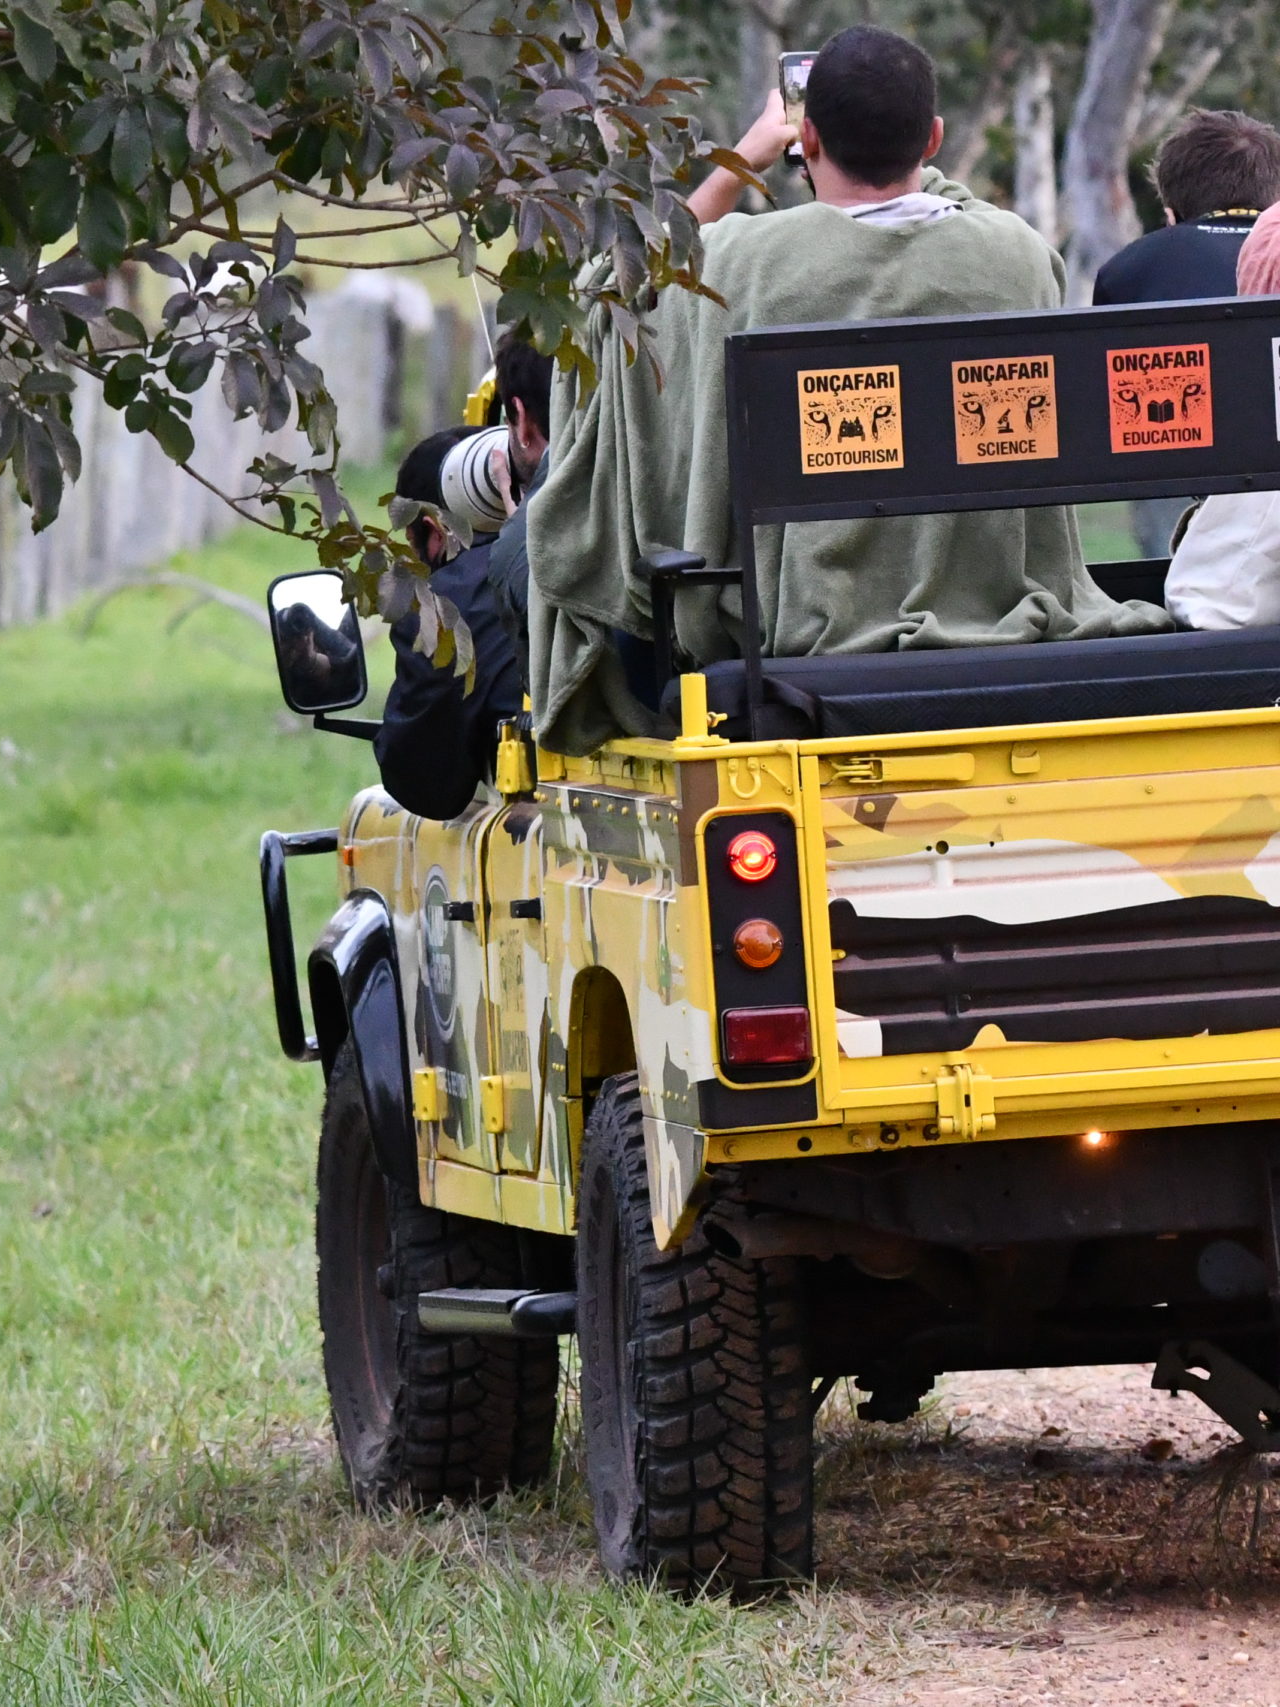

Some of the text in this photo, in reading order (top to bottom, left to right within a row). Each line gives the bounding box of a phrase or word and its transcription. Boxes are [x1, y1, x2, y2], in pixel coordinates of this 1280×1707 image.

[1112, 350, 1204, 375] ONÇAFARI
[803, 371, 895, 397] ONÇAFARI
[957, 361, 1049, 387] ONÇAFARI
[1122, 427, 1202, 446] EDUCATION
[807, 448, 899, 467] ECOTOURISM
[977, 439, 1037, 457] SCIENCE
